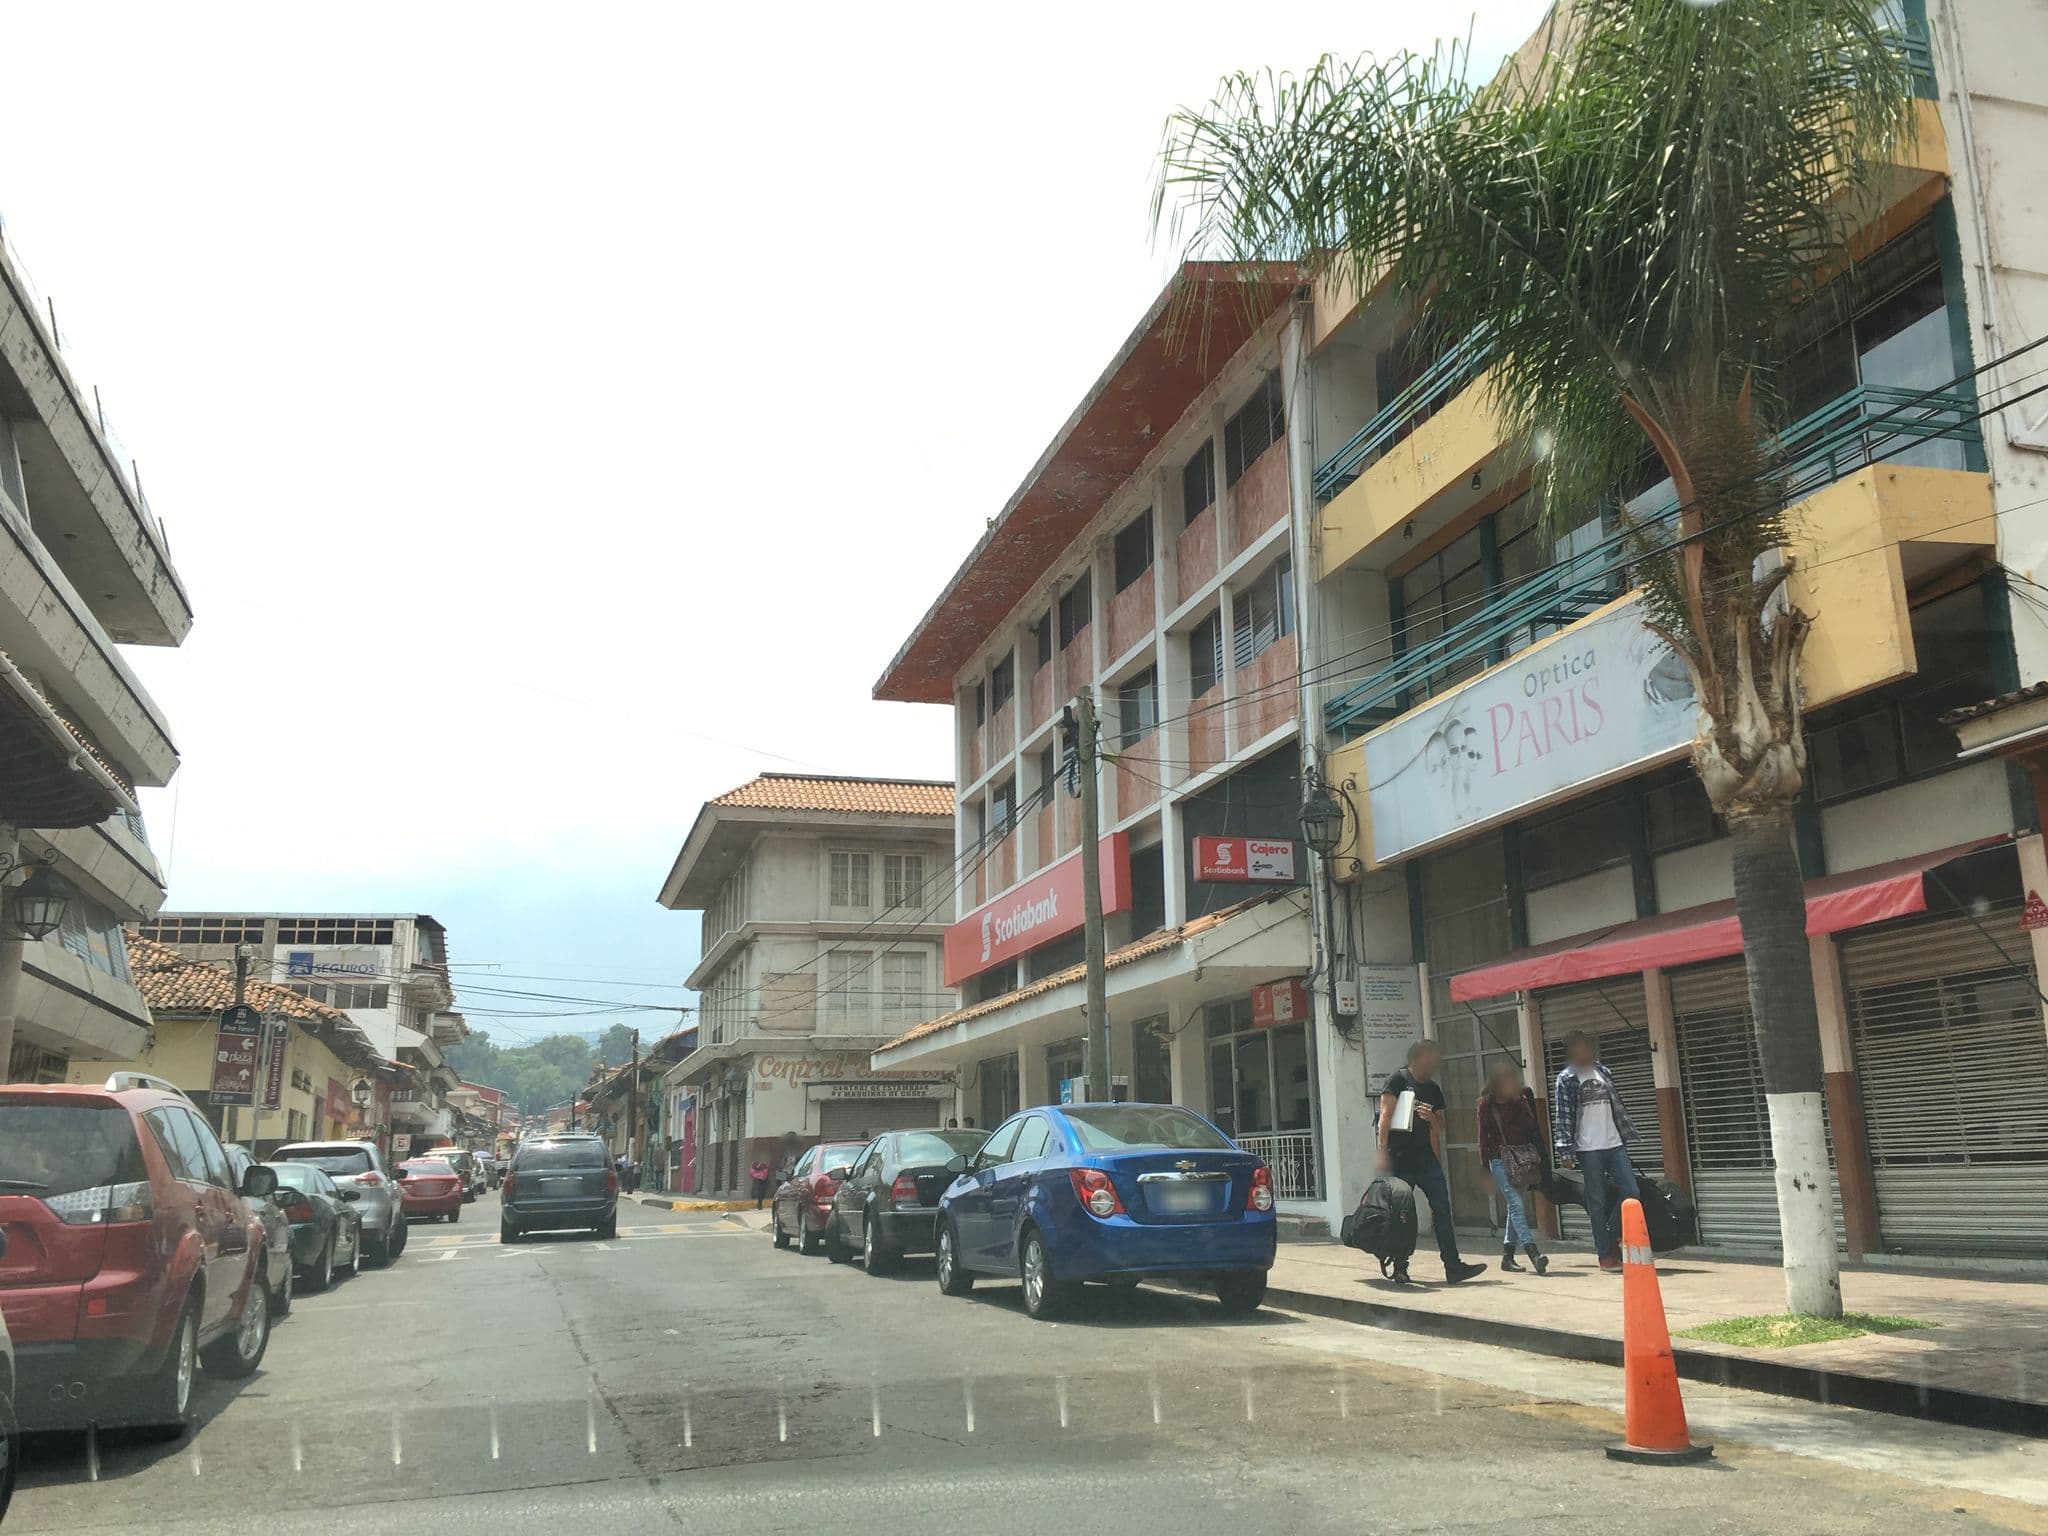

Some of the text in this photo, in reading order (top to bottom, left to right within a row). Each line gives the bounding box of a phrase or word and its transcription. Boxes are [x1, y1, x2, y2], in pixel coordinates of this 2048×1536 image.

[1524, 648, 1596, 698] Optica
[1486, 675, 1604, 776] PARIS
[1250, 843, 1289, 856] Cajero
[1203, 866, 1246, 875] Scotiabank
[994, 887, 1058, 944] Scotiabank
[315, 962, 376, 975] SEGUROS
[758, 1053, 845, 1089] Central
